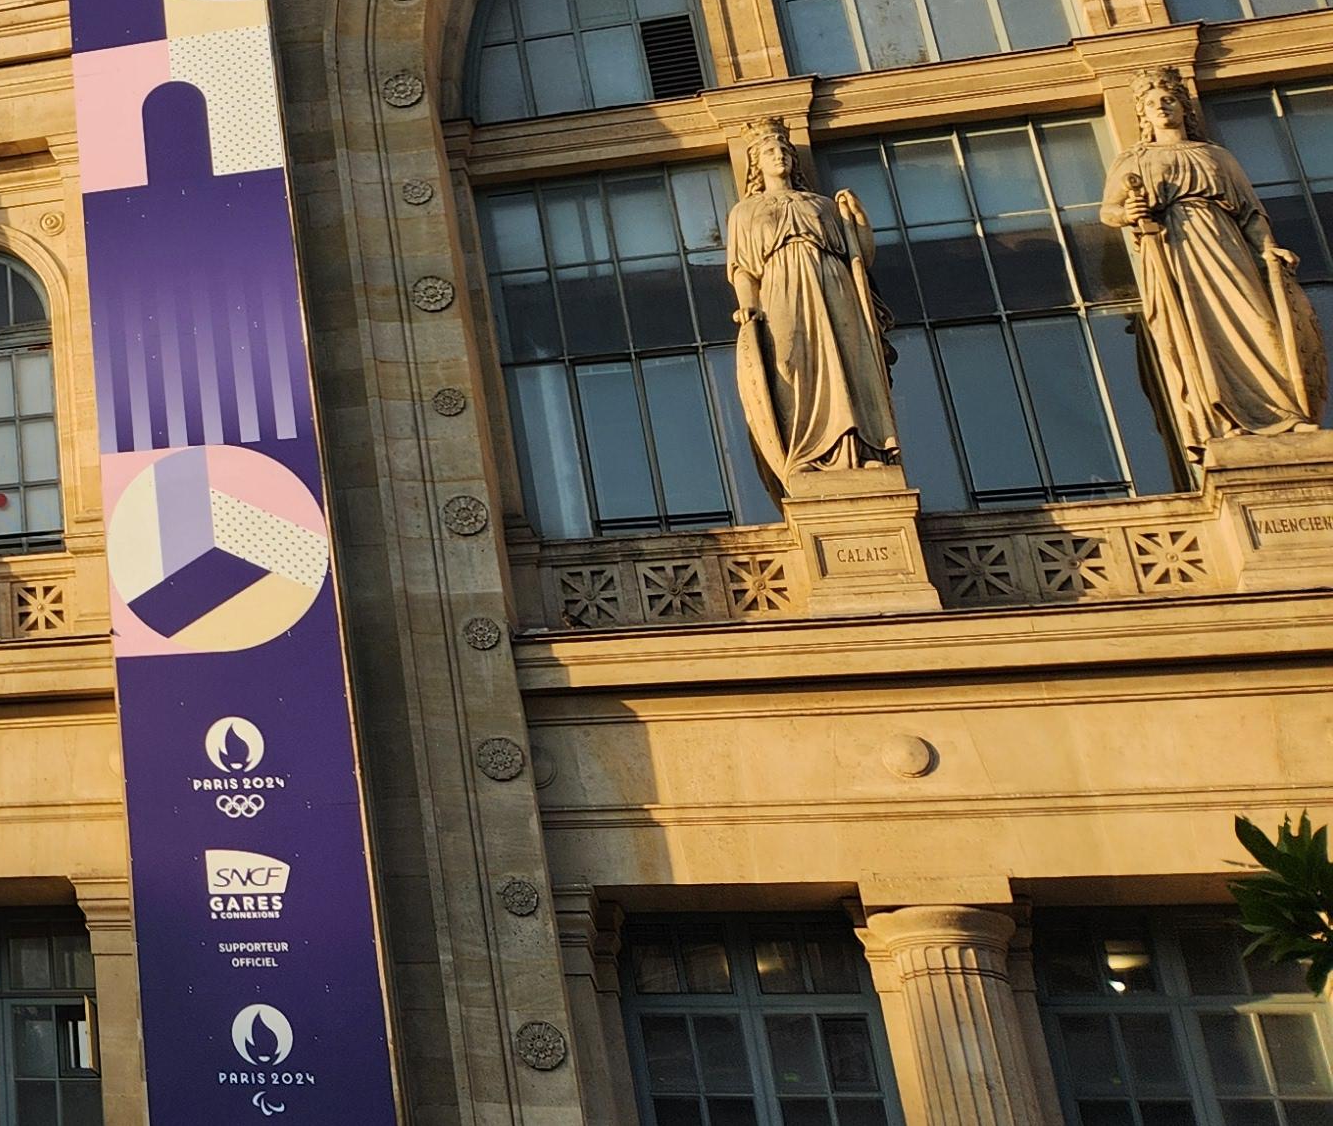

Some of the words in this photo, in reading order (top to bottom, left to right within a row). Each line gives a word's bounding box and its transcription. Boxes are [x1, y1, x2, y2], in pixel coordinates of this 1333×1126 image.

[836, 546, 889, 563] CALAIS
[192, 778, 239, 791] PARIS
[242, 776, 285, 789] 2024
[213, 867, 283, 887] SNCF
[209, 895, 283, 912] GARES
[220, 910, 280, 920] CONNEXIONS
[218, 942, 289, 953] SUPPORTEUR
[231, 957, 279, 967] OFFICIEL
[218, 1073, 266, 1085] PARIS
[271, 1073, 315, 1085] 2024
